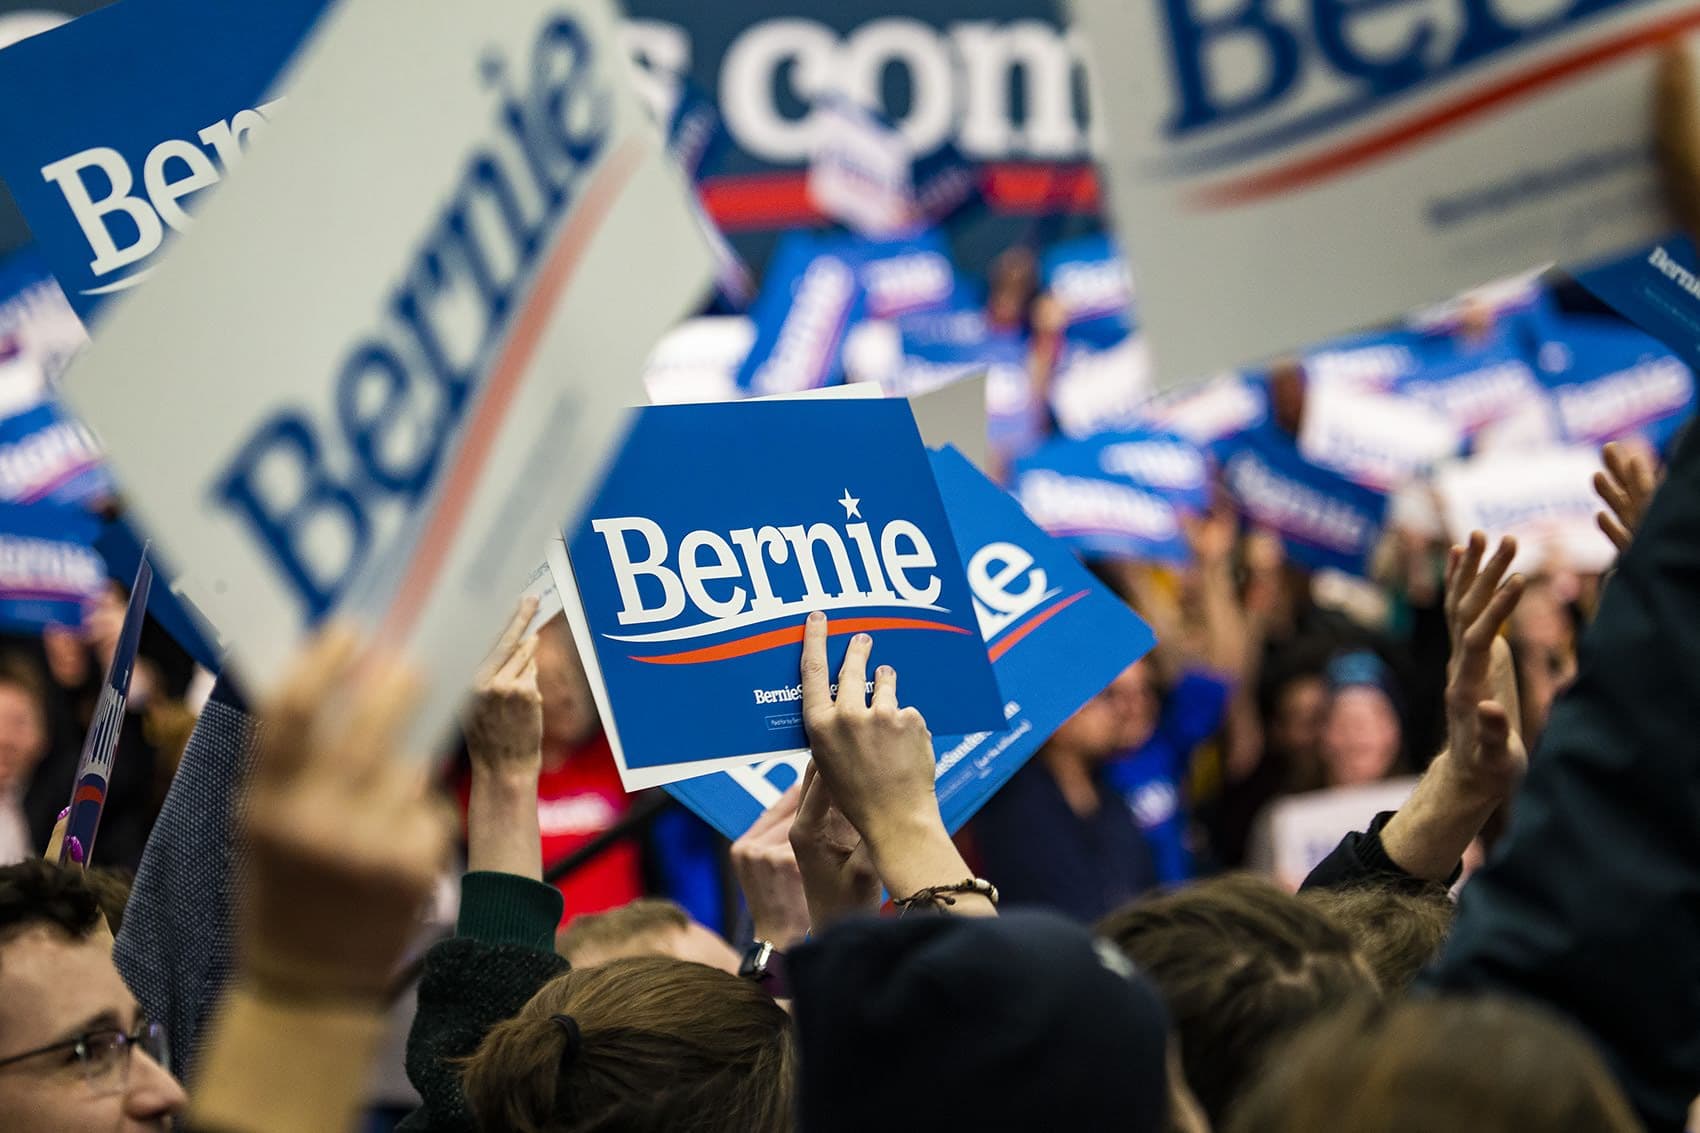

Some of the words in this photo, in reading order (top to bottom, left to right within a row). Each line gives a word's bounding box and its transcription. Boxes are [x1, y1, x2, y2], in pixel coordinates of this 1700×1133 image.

[41, 97, 286, 277] Ber
[205, 11, 607, 625] Bernie
[591, 489, 942, 626] Bernie
